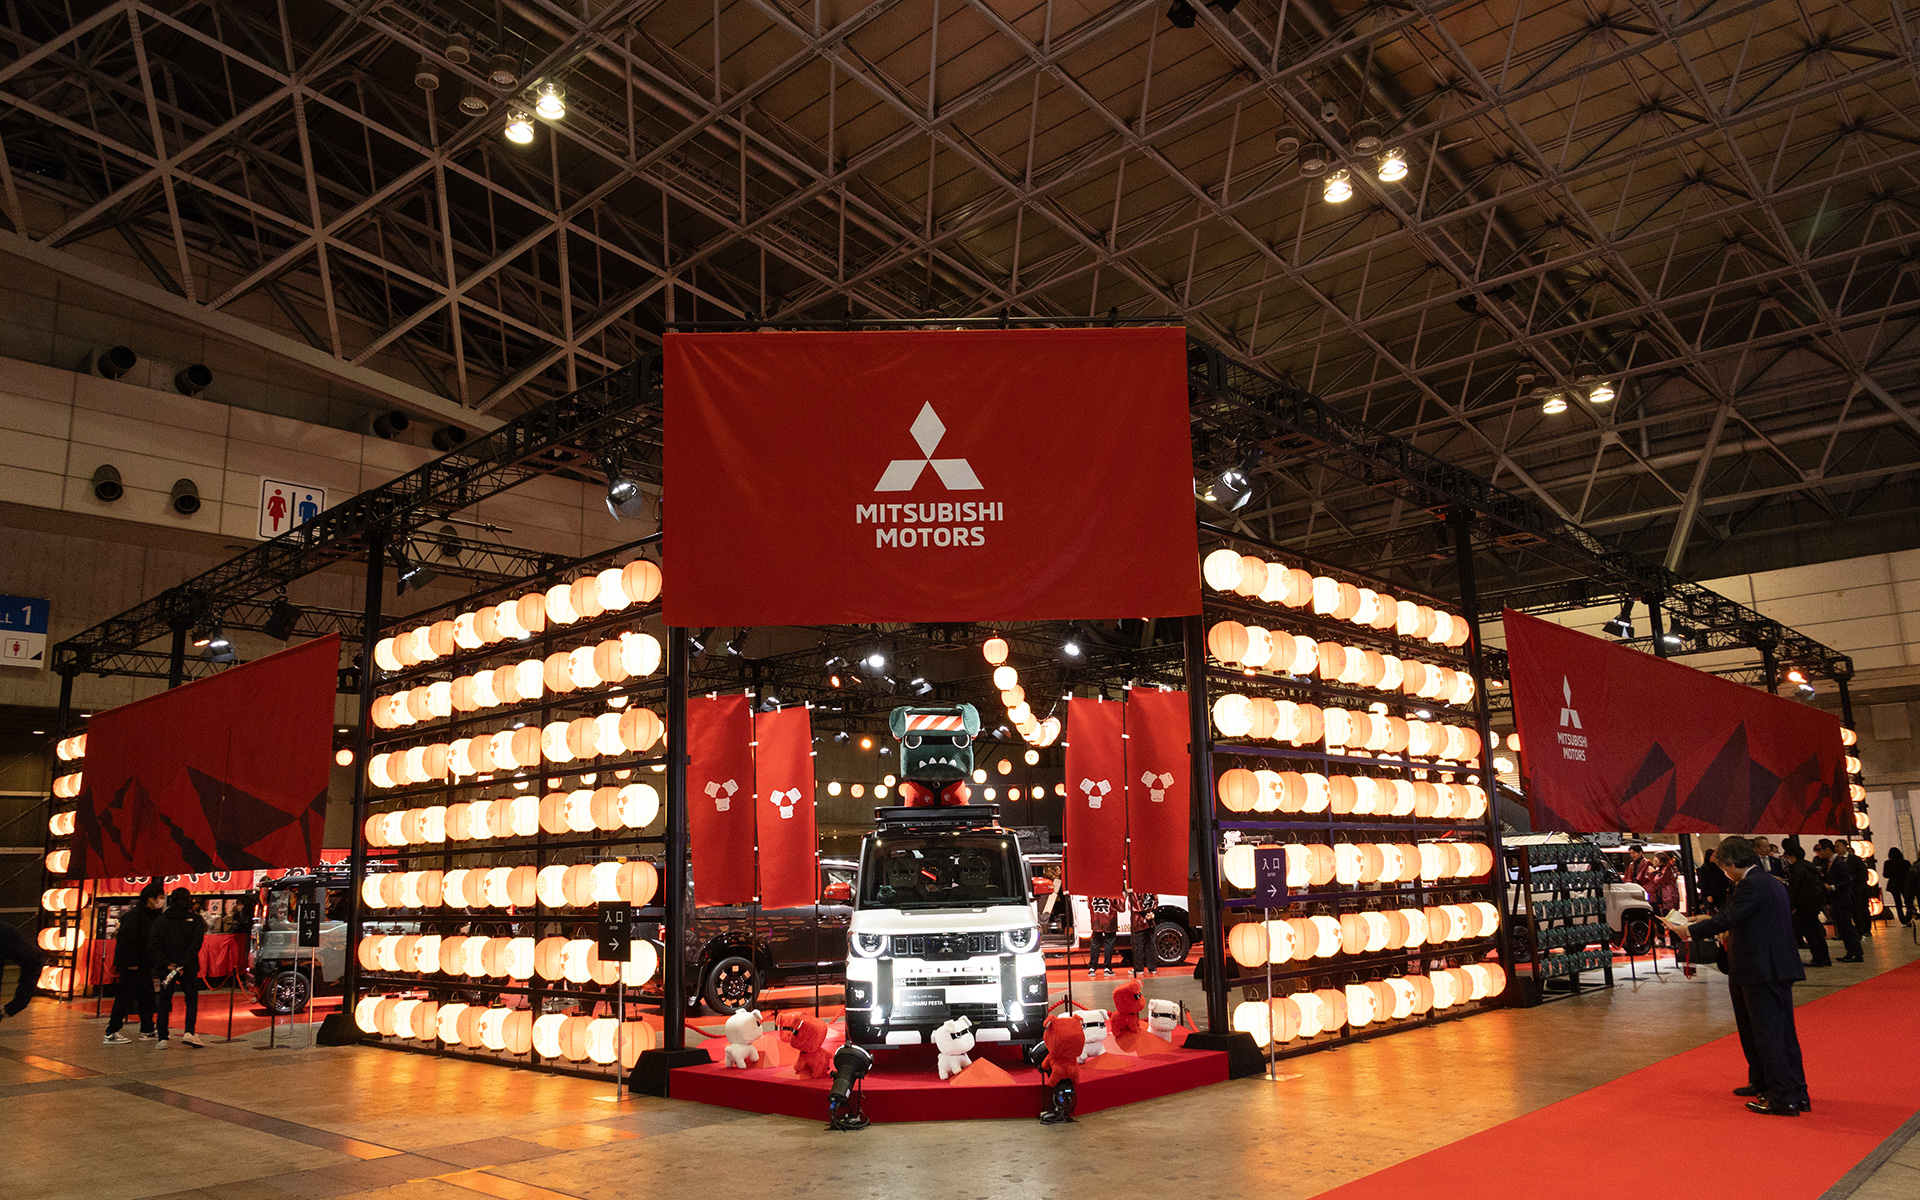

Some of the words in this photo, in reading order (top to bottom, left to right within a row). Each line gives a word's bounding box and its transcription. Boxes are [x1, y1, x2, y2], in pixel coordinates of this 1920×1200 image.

[856, 502, 1004, 523] MITSUBISHI
[876, 526, 986, 548] MOTORS
[22, 605, 32, 626] 1
[1557, 732, 1588, 748] MITSUBISHI
[1562, 747, 1586, 762] MOTORS
[1262, 858, 1280, 870] 入口
[303, 910, 316, 919] 入口
[604, 911, 624, 923] 入口
